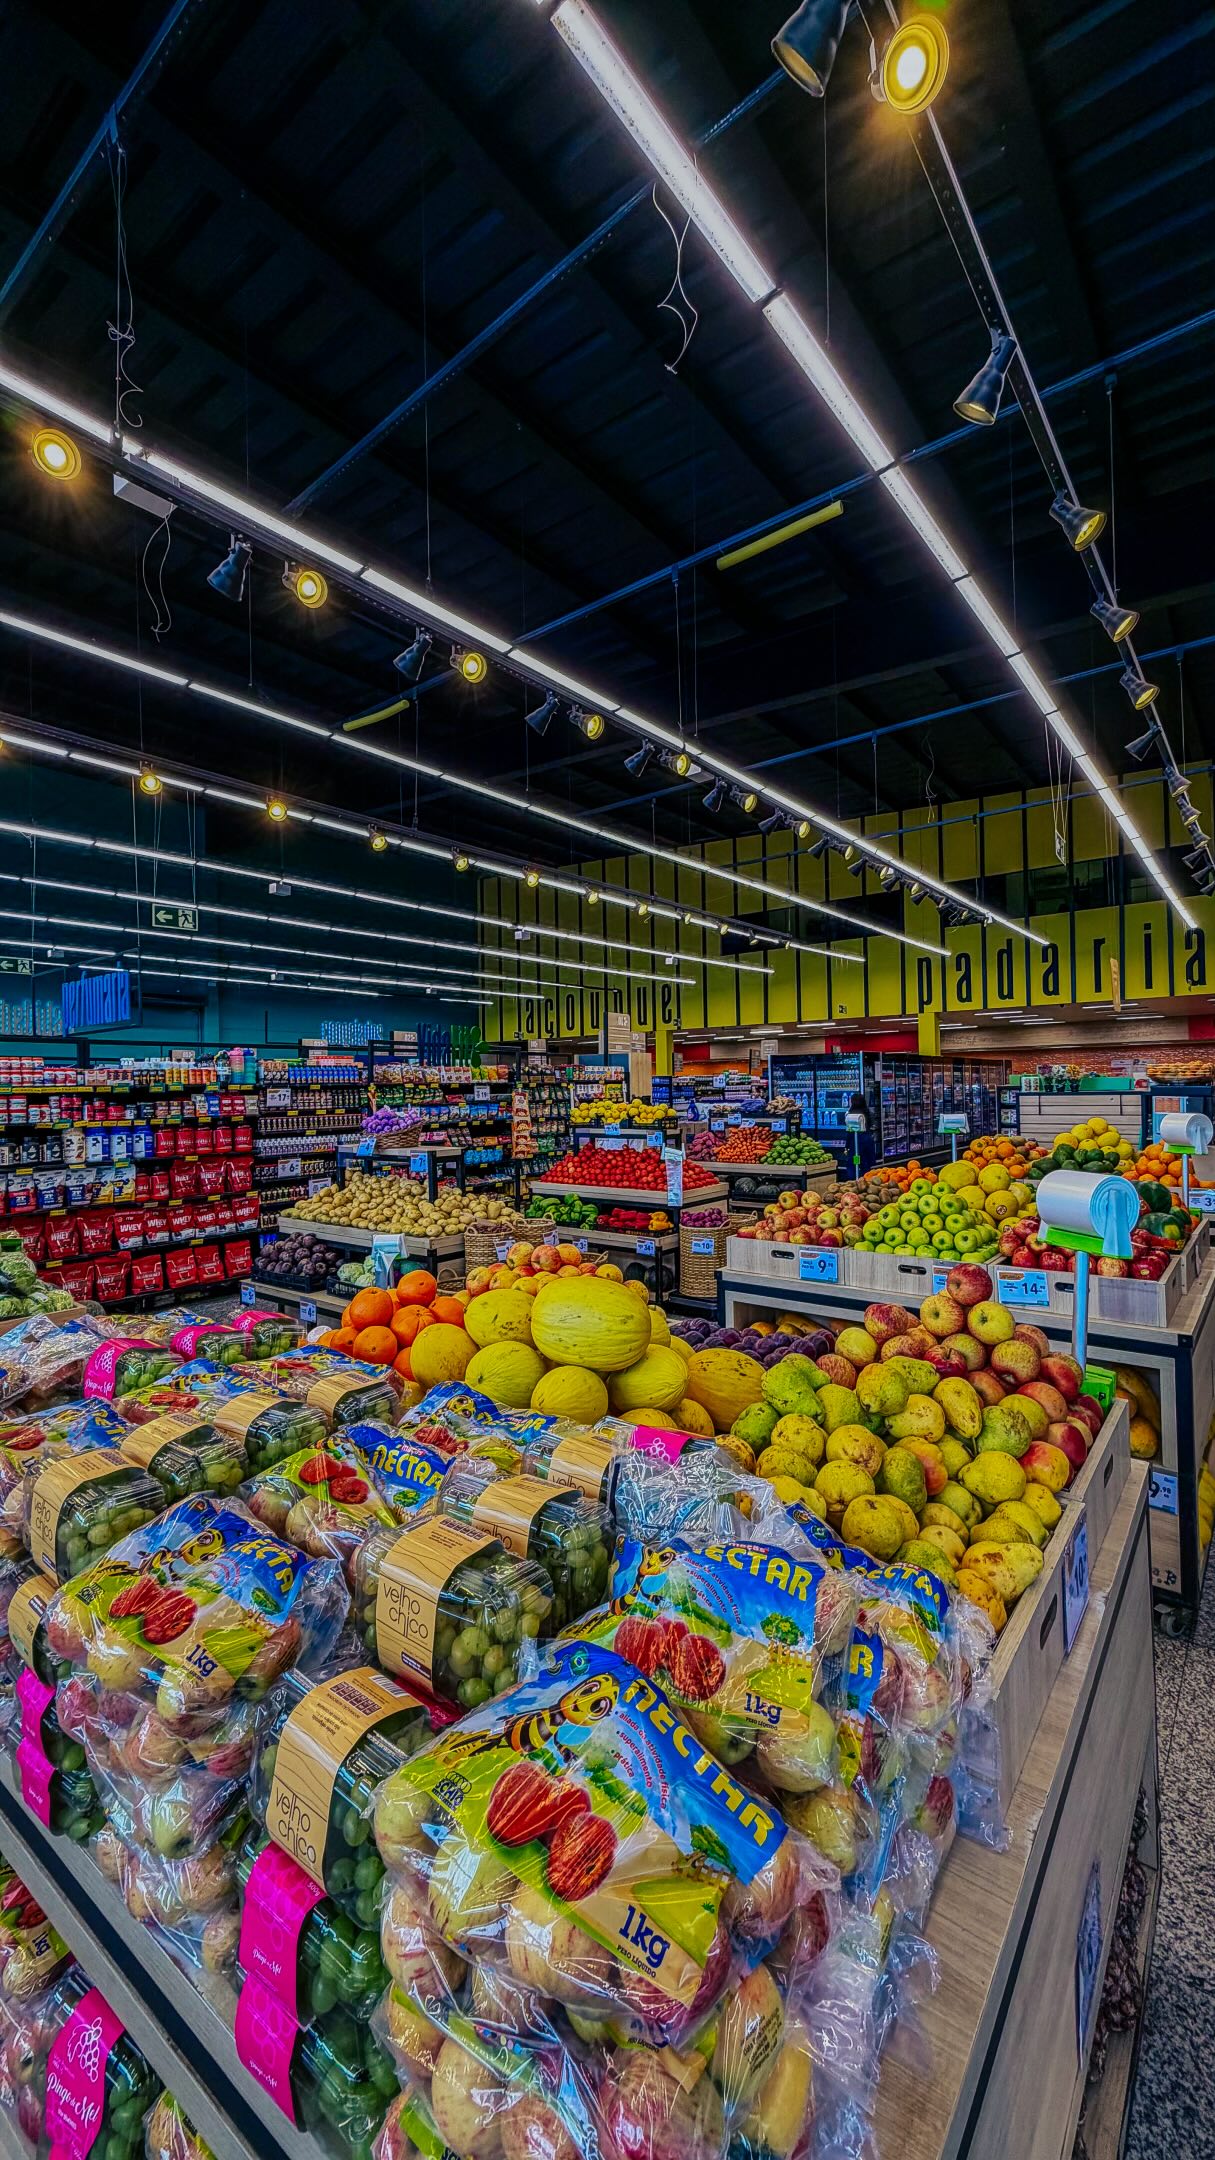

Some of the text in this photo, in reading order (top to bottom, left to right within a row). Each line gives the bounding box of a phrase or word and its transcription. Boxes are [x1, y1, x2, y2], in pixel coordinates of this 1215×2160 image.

[917, 923, 1206, 1014] padaria
[62, 962, 130, 1037] perfumaria
[278, 1094, 287, 1102] 17
[290, 1163, 294, 1172] 6
[147, 1219, 166, 1228] WHEY
[172, 1215, 192, 1225] WHEY
[198, 1212, 216, 1222] WHEY
[236, 1206, 256, 1216] WHEY
[51, 1232, 69, 1240] WHEY
[84, 1229, 100, 1237] WHEY
[120, 1224, 142, 1232] WHEY
[63, 1282, 80, 1290] WHEY
[1022, 1282, 1038, 1294] 14
[34, 1500, 50, 1522] velho
[36, 1517, 53, 1542] chico
[383, 1583, 421, 1614] velho
[690, 1570, 727, 1614] superalimento
[691, 1586, 713, 1608] prática
[712, 1572, 734, 1604] atividade
[388, 1607, 428, 1640] chico
[186, 1644, 218, 1677] 1kg
[744, 1692, 783, 1724] 1kg
[613, 1752, 634, 1778] prática
[619, 1712, 640, 1731] aliada
[646, 1739, 666, 1780] atividade
[660, 1782, 670, 1810] física
[620, 1732, 652, 1788] superalimento
[275, 1787, 311, 1833] velho
[278, 1818, 317, 1864] chico
[306, 1882, 321, 1897] 500g
[619, 1904, 671, 1969] 1kg
[616, 1944, 656, 1979] PESO LÍQUIDO
[47, 2072, 70, 2105] Pingo
[74, 2096, 98, 2129] Mel
